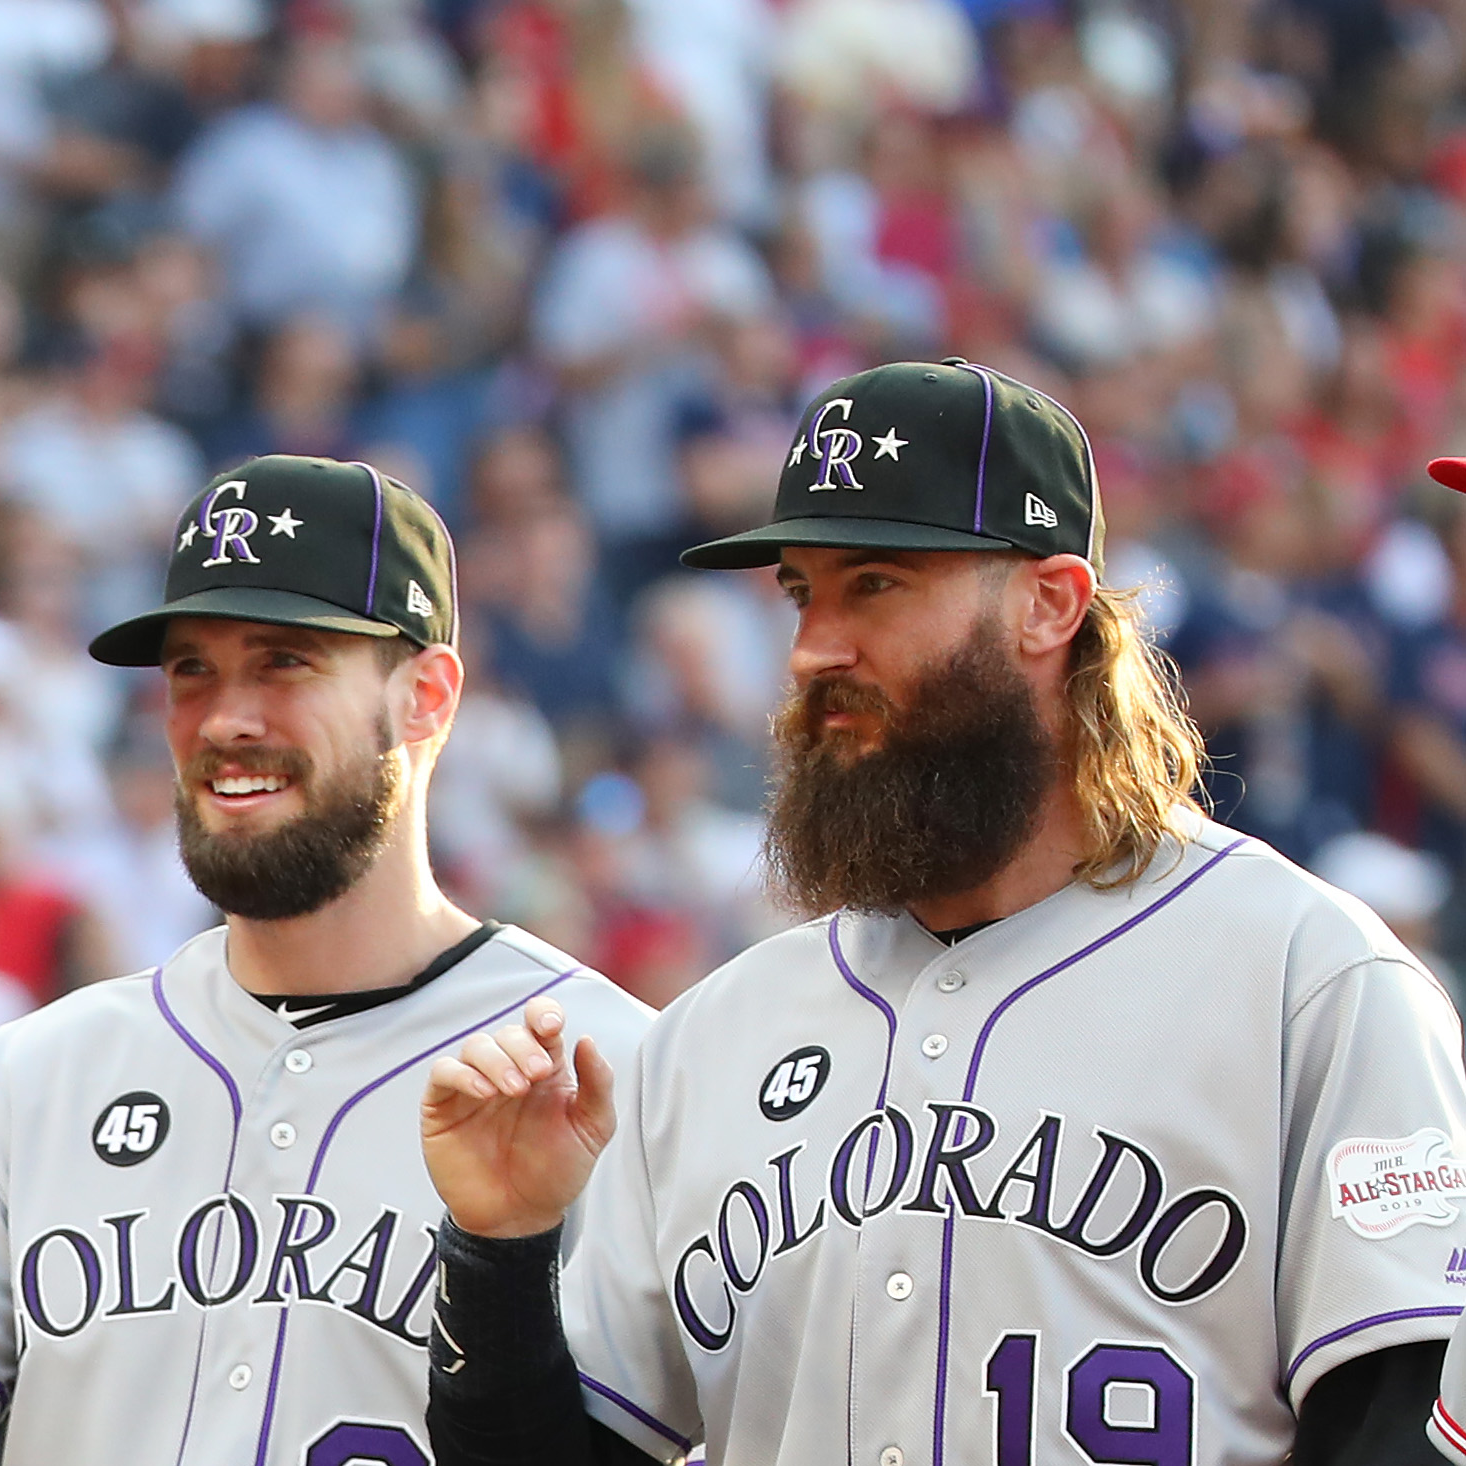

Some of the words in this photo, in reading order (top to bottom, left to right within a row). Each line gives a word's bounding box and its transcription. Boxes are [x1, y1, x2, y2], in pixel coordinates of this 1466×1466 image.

[763, 1054, 820, 1109] 45
[95, 1103, 161, 1154] 45
[670, 1098, 1249, 1355] COLORADO
[1381, 1199, 1423, 1212] 2019
